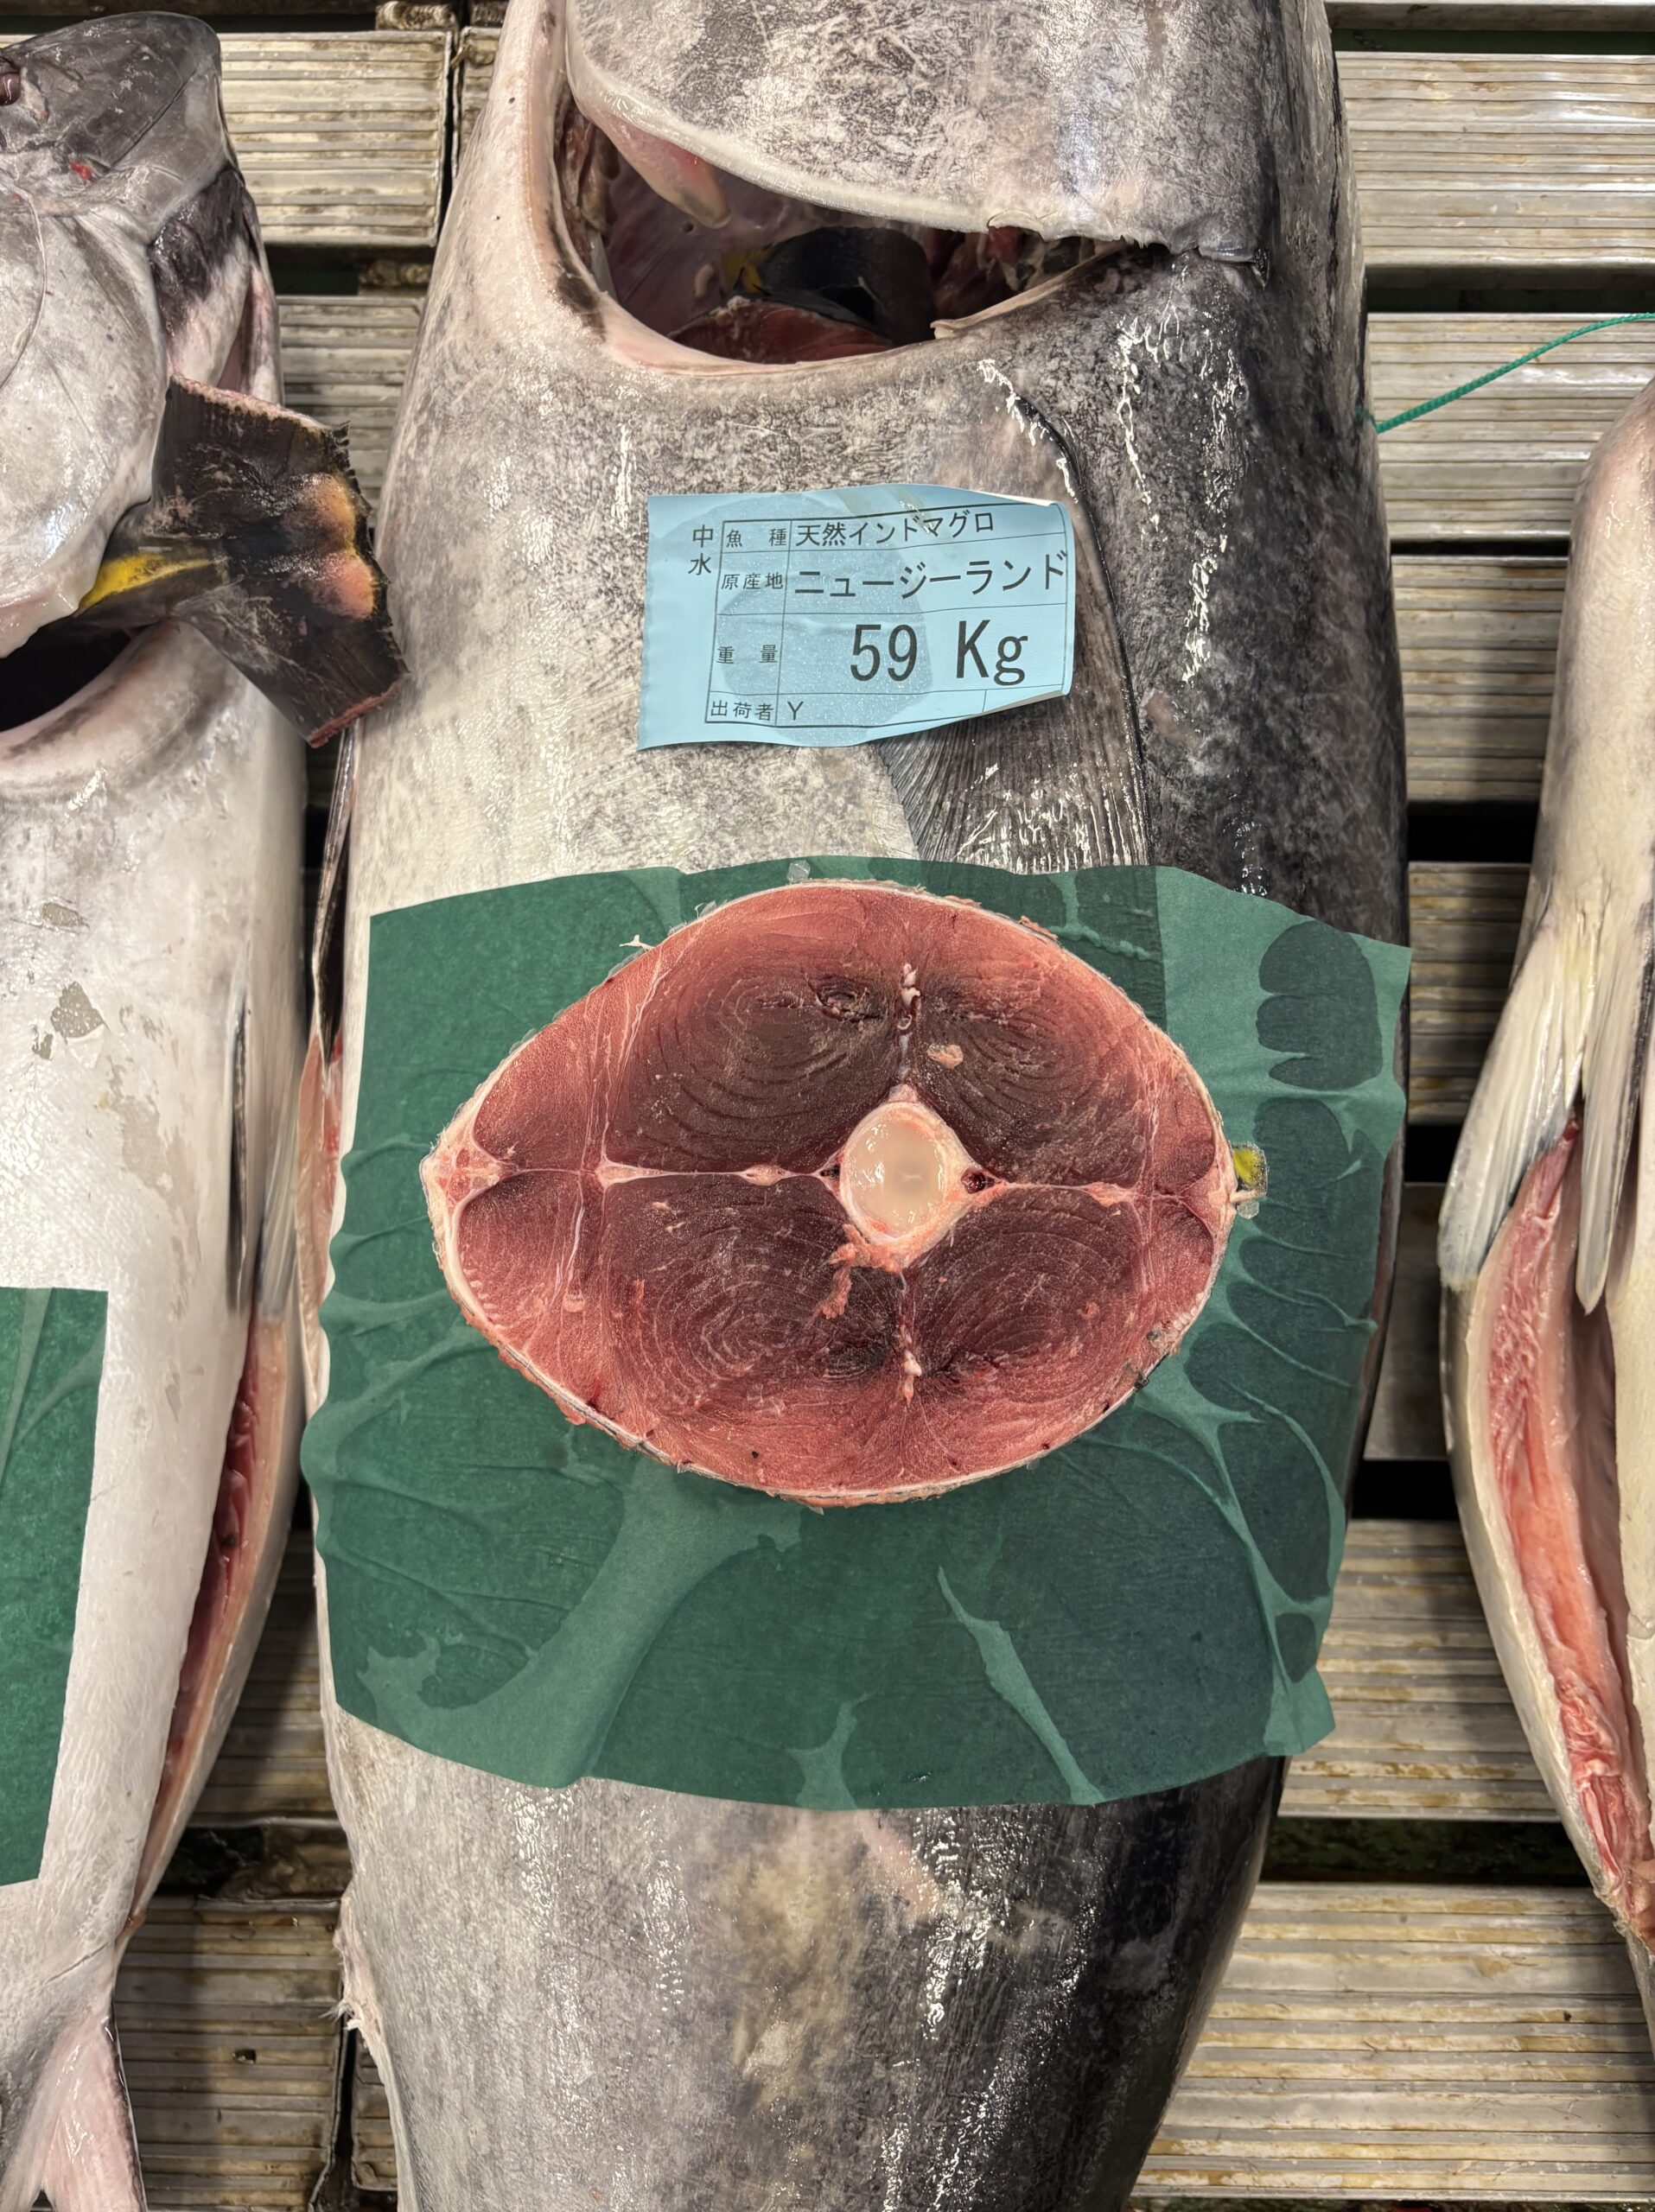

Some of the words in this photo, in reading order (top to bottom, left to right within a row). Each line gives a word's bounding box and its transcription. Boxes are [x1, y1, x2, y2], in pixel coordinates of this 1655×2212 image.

[795, 512, 995, 547] 天然インドマグロ
[720, 572, 784, 591] 原産地
[793, 550, 1067, 600] ニュージーランド
[850, 624, 918, 683] 59
[956, 620, 1028, 686] Kg
[710, 700, 775, 722] 出荷者
[788, 701, 805, 721] Y
